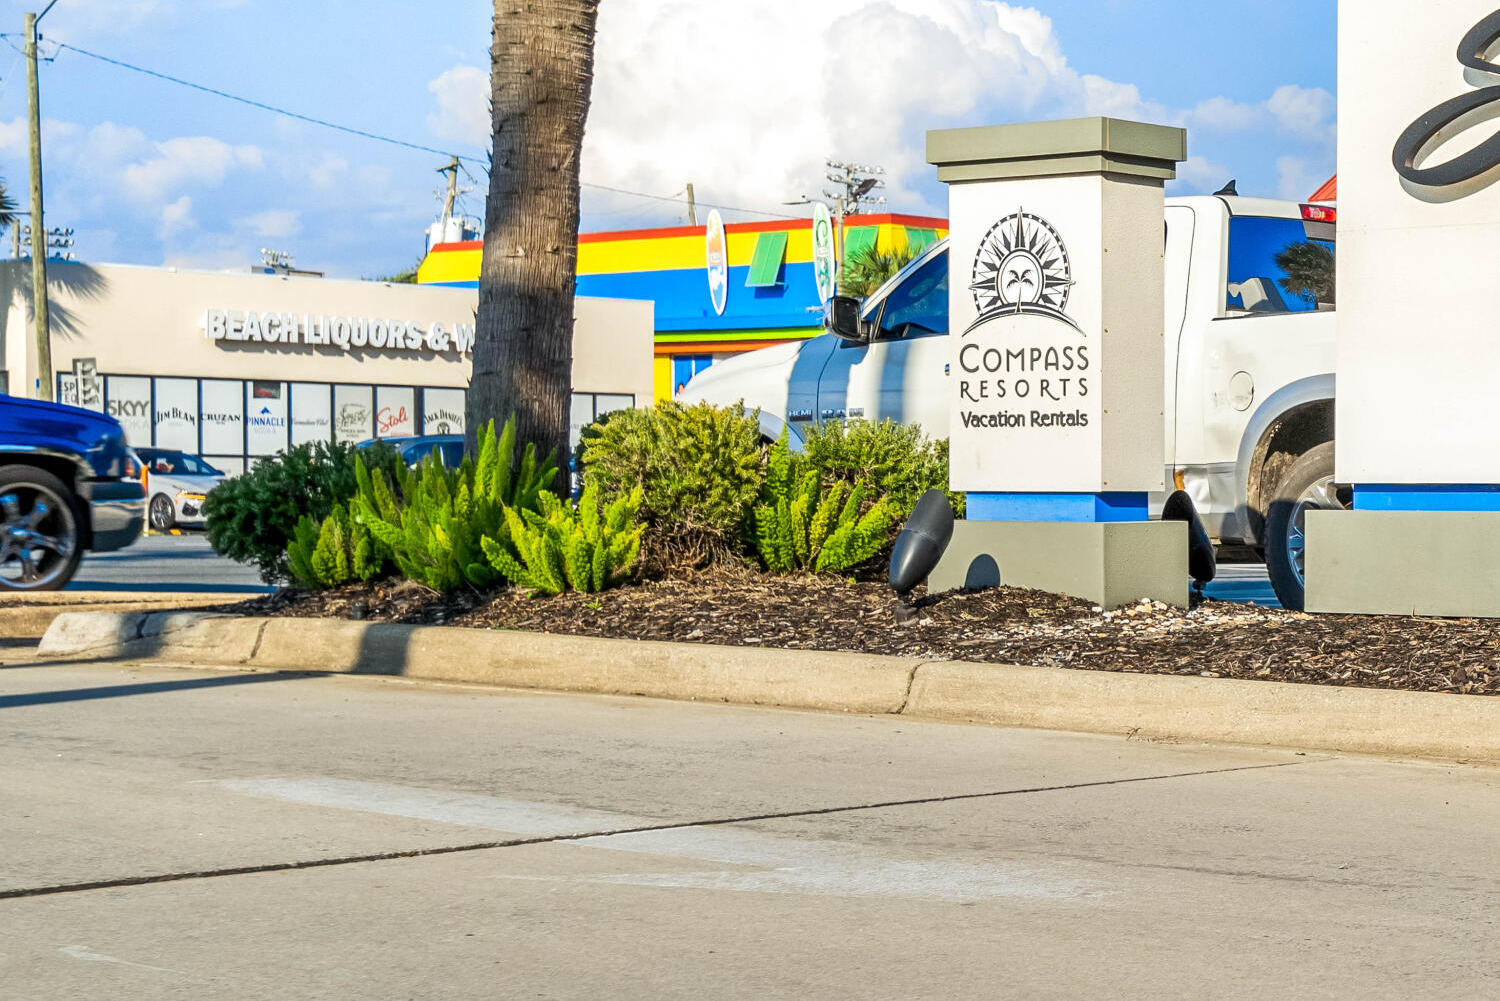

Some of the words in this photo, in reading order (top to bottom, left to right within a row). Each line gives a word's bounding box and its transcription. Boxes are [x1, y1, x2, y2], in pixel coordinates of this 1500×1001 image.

[205, 309, 299, 345] BEACH
[304, 314, 424, 351] LIQUORS
[427, 322, 450, 351] &
[959, 343, 1089, 374] COMPASS
[960, 378, 1088, 403] RESORTS
[108, 399, 149, 417] SKYY
[155, 410, 170, 425] JIM
[200, 413, 240, 422] CRUZAN
[247, 416, 286, 427] PINNACLE
[377, 406, 408, 433] Stoli
[960, 410, 1026, 429] Vacation
[1030, 409, 1089, 428] Rentals
